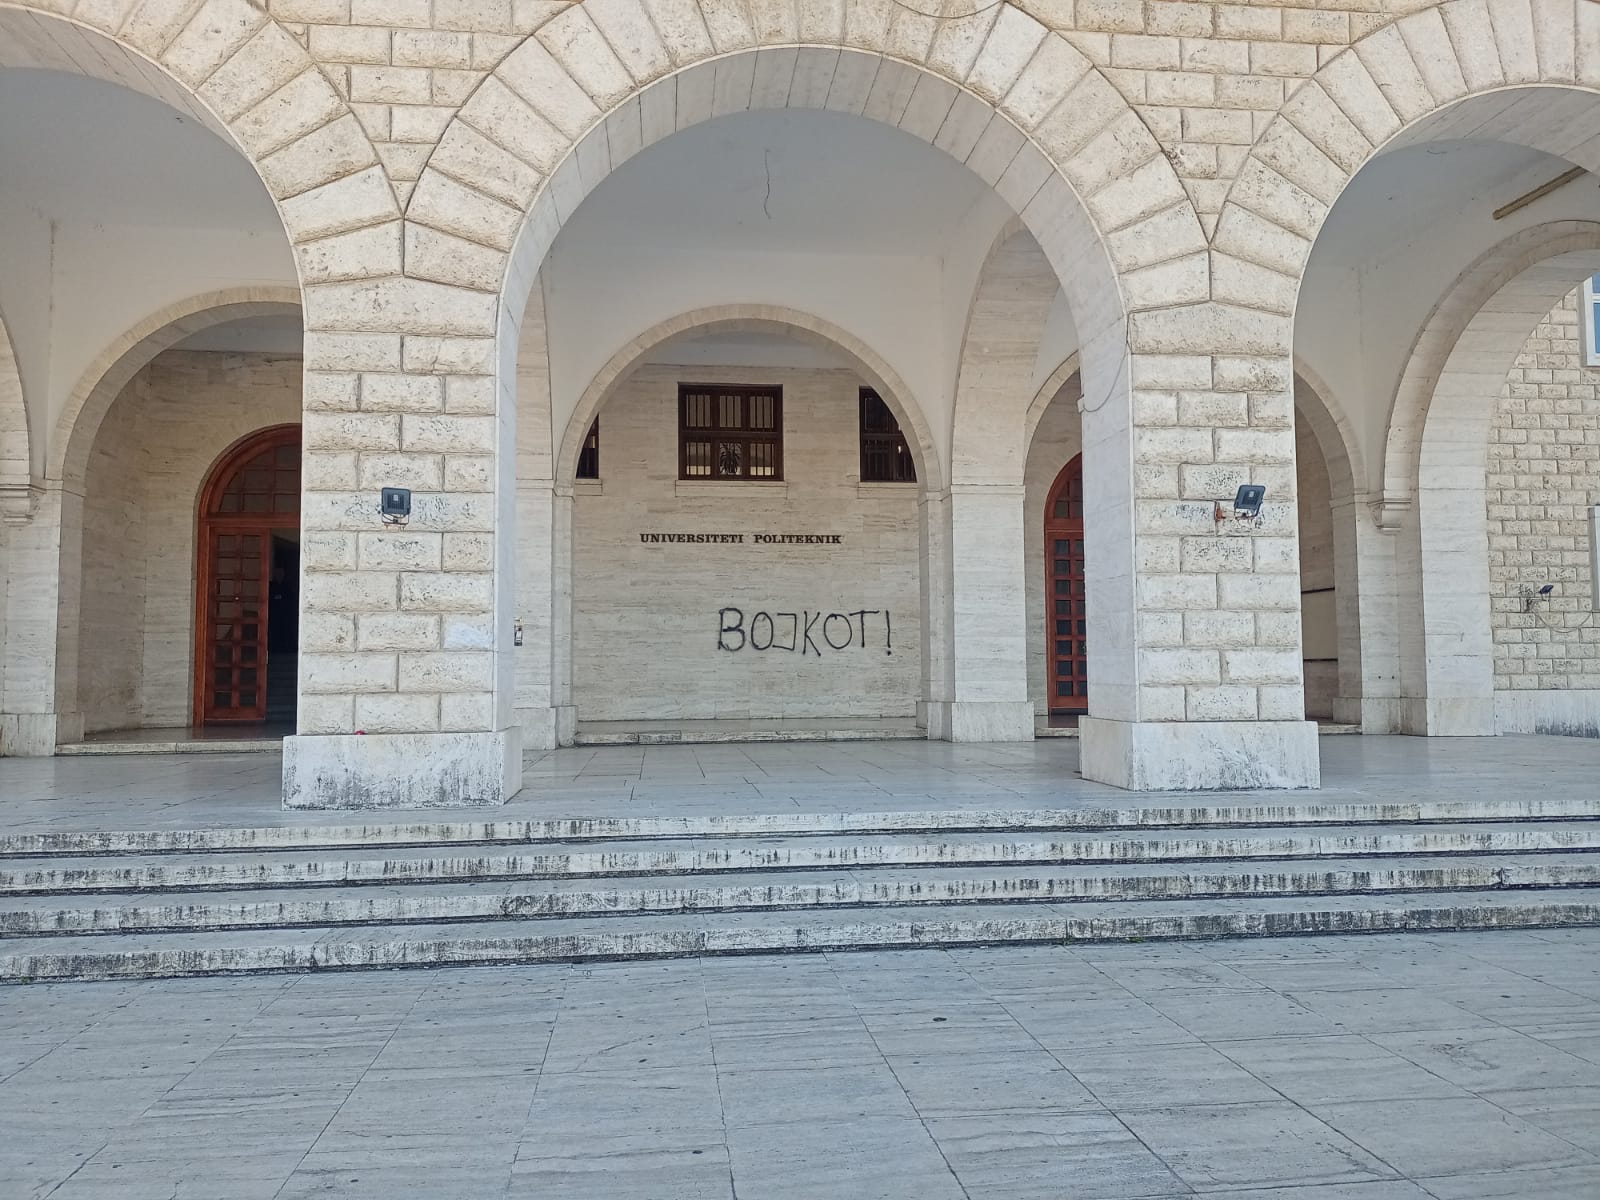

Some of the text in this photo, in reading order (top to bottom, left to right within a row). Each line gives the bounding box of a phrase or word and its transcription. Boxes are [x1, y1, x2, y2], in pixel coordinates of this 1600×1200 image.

[640, 533, 842, 545] UNIVERSITETI POLITEKNIK
[717, 607, 892, 656] BOJKOT!
